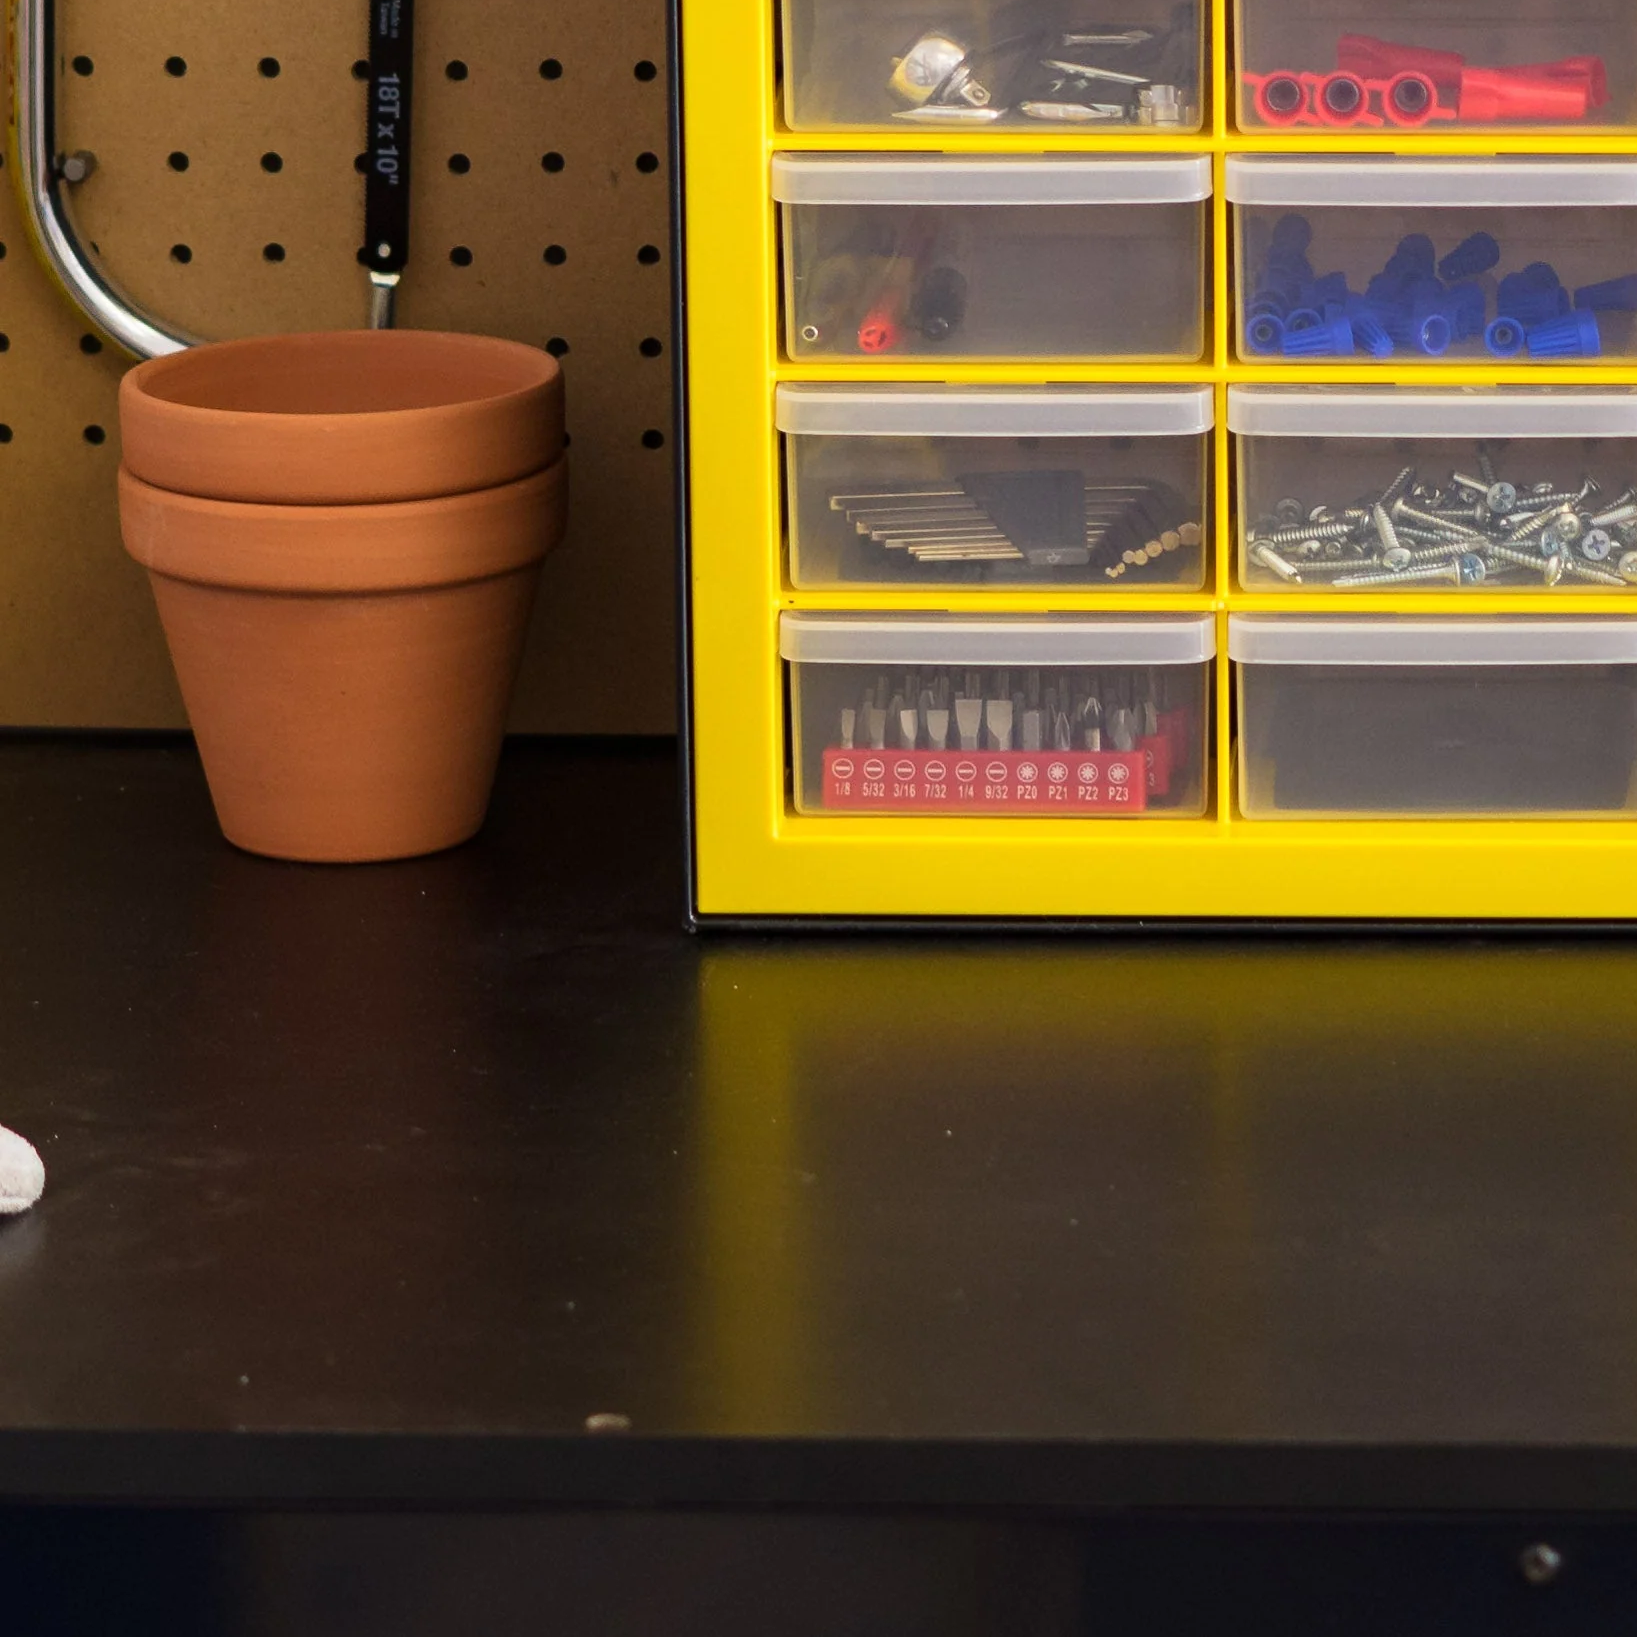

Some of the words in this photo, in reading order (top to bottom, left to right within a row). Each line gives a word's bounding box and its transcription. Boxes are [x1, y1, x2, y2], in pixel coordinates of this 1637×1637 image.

[378, 72, 400, 119] 18T
[377, 123, 395, 139] x
[862, 782, 885, 797] 5/32
[893, 783, 916, 798] 3/16
[924, 784, 947, 799] 7/32
[958, 785, 975, 799] 1/4
[985, 785, 1008, 799] 9/32
[1017, 785, 1038, 800] PZ0
[1048, 785, 1068, 801] PZ1
[1078, 786, 1099, 801] PZ2
[1108, 786, 1129, 801] PZ3
